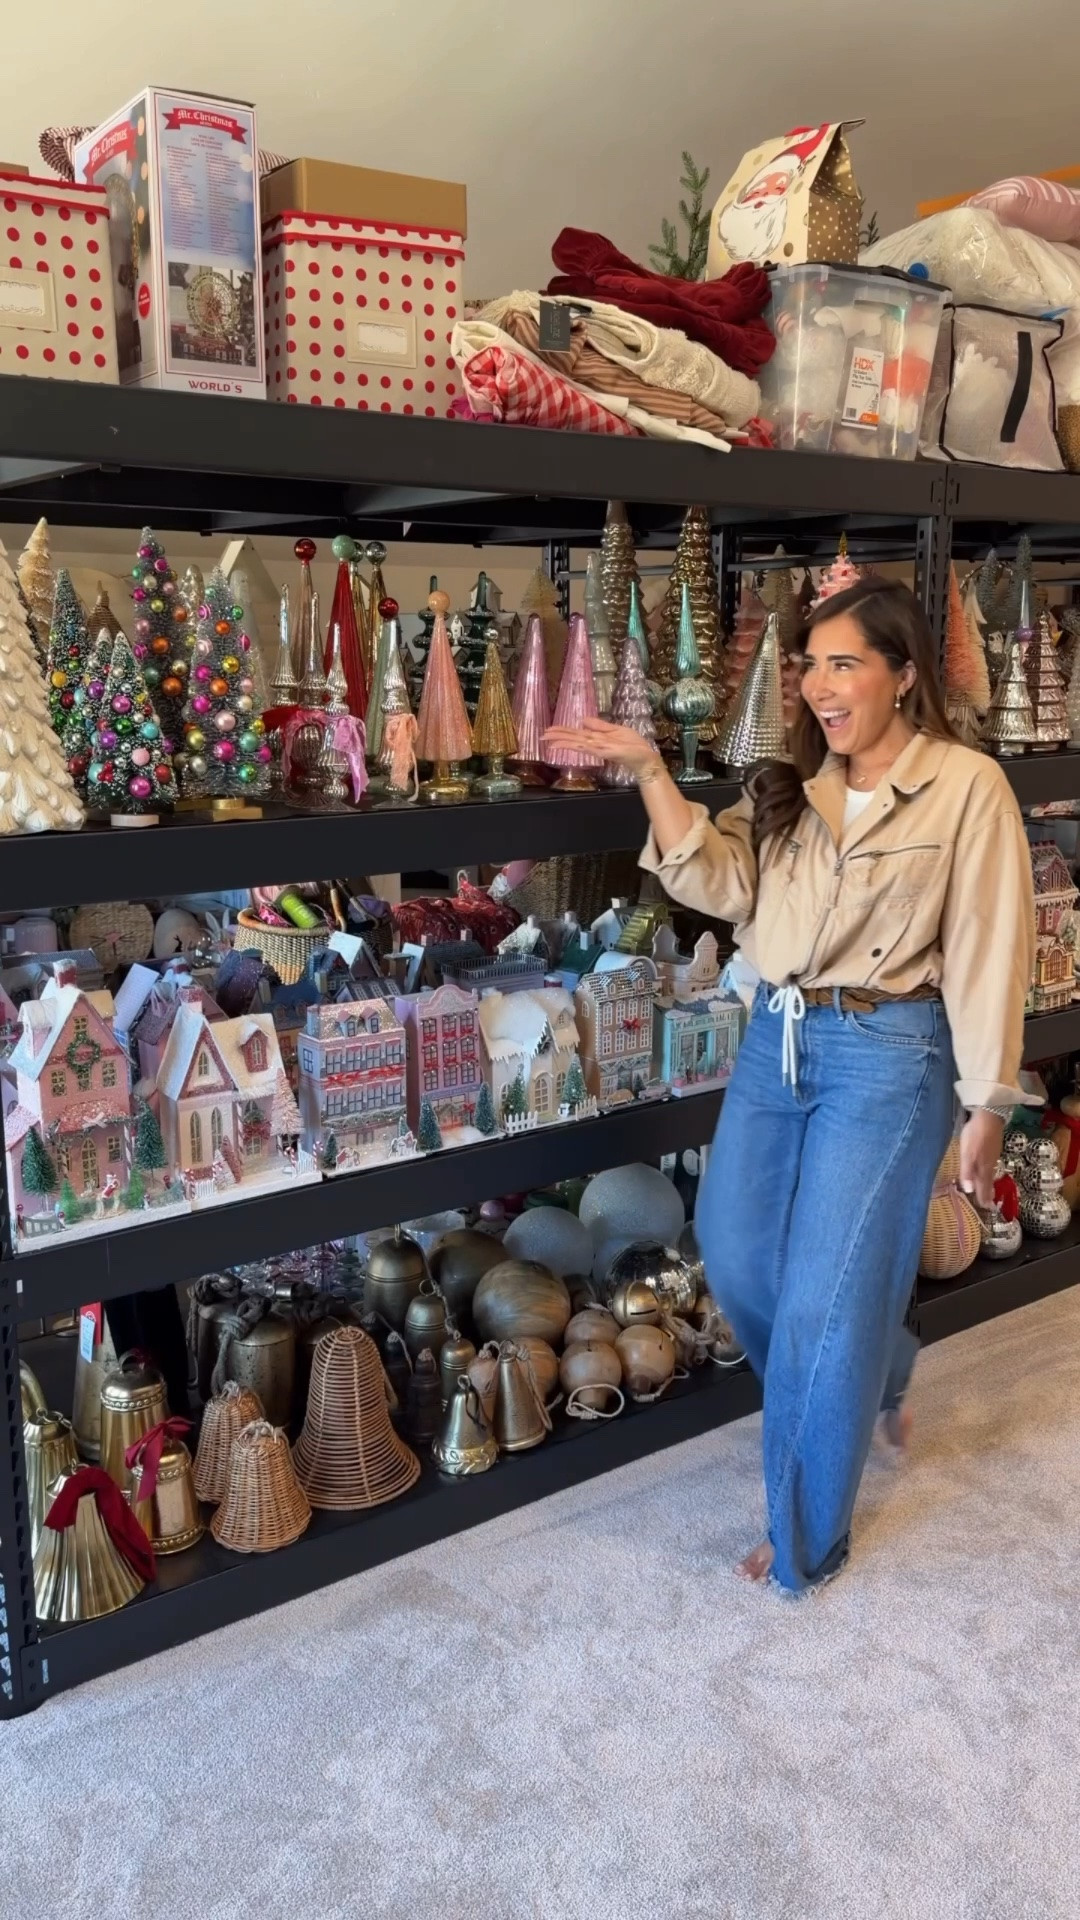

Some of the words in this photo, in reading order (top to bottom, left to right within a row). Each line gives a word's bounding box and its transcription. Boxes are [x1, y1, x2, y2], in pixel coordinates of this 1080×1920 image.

[178, 110, 193, 120] Mr.
[193, 111, 234, 128] Christmas
[101, 129, 127, 153] Christmas
[854, 357, 875, 371] HDX
[188, 380, 243, 393] WORLD'S
